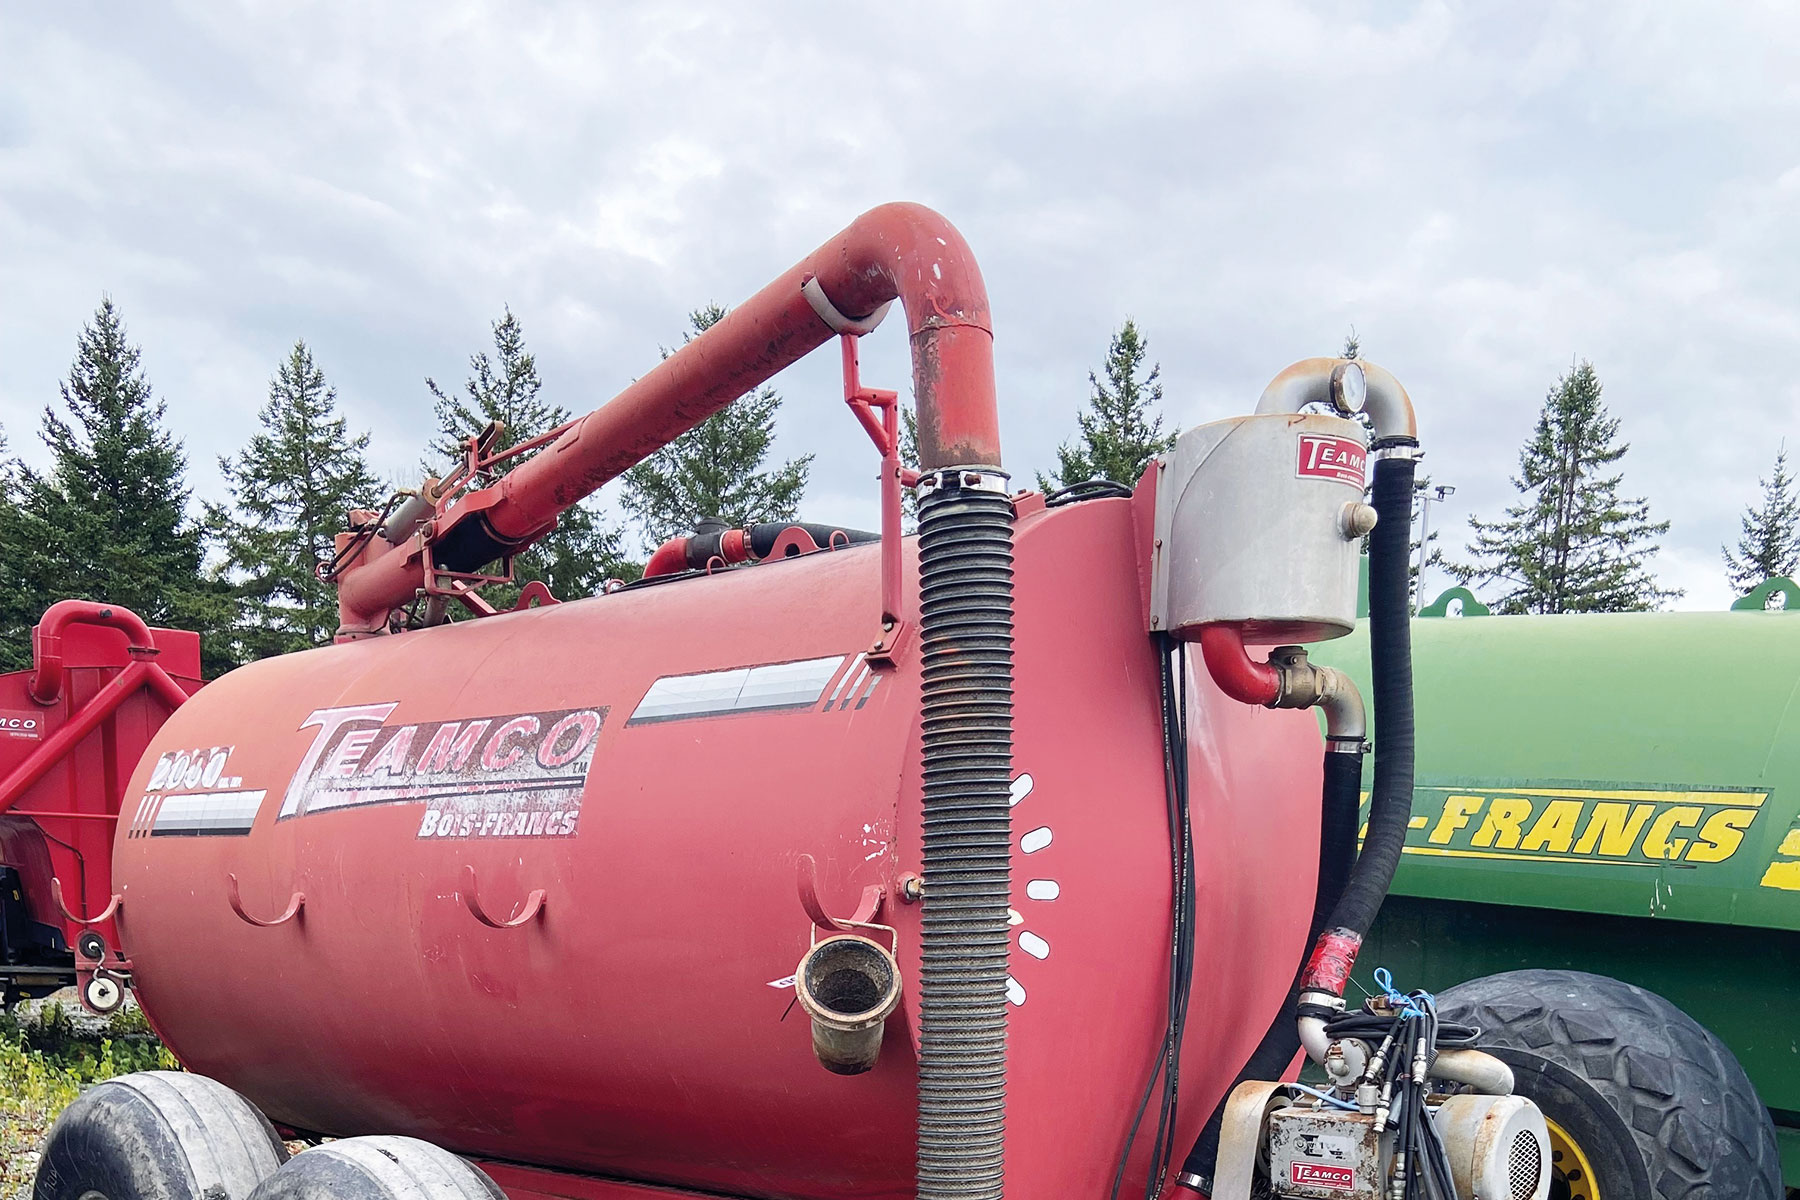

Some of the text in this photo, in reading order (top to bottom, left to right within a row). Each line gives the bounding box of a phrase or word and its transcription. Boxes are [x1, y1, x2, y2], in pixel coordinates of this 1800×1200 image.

[276, 700, 602, 825] TEAMCO
[417, 809, 579, 838] BOIS-FRANCS
[1294, 1164, 1351, 1181] TEAMCO
